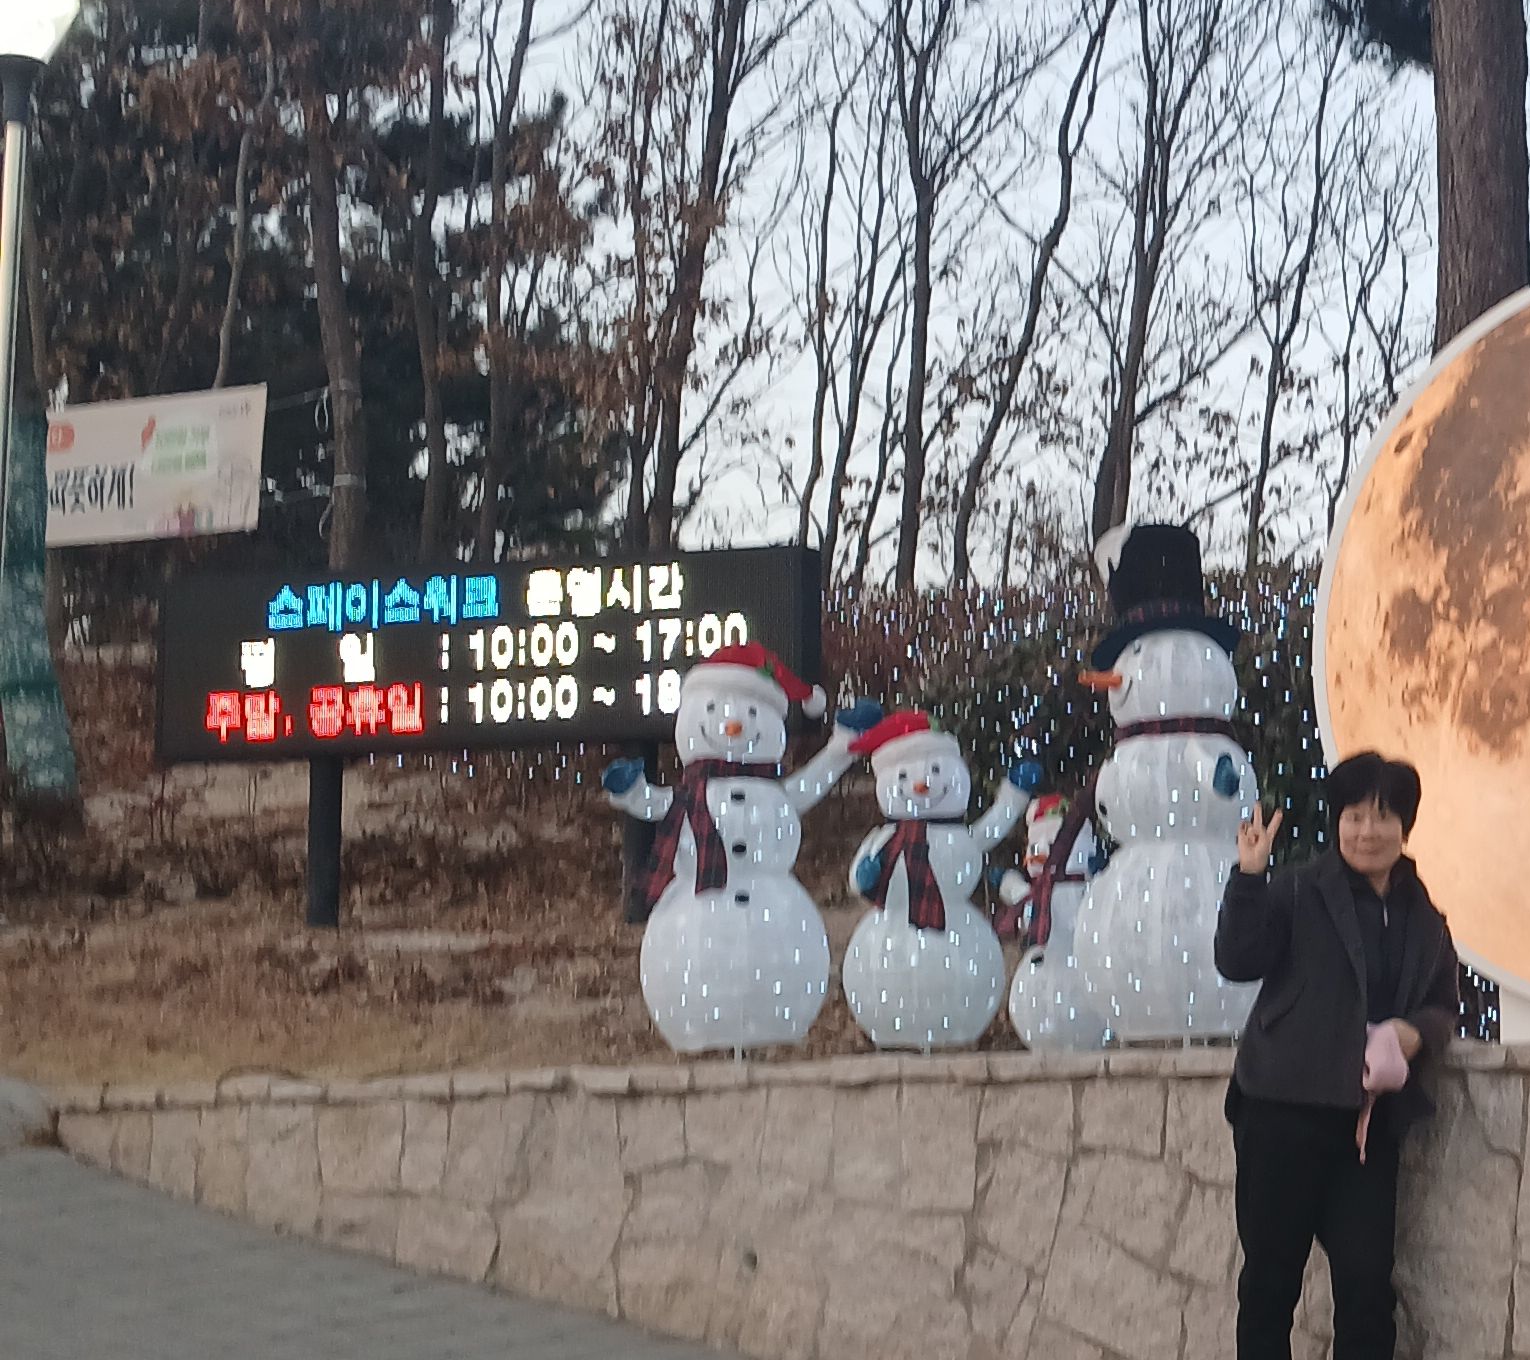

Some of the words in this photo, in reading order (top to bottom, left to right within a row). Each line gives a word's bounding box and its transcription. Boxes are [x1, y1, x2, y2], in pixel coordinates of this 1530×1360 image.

[268, 574, 499, 632] 스페이스워크
[469, 621, 579, 672] 10:00
[636, 612, 748, 662] 17:00
[309, 682, 423, 738] 공휴일
[468, 674, 579, 722] 10:00
